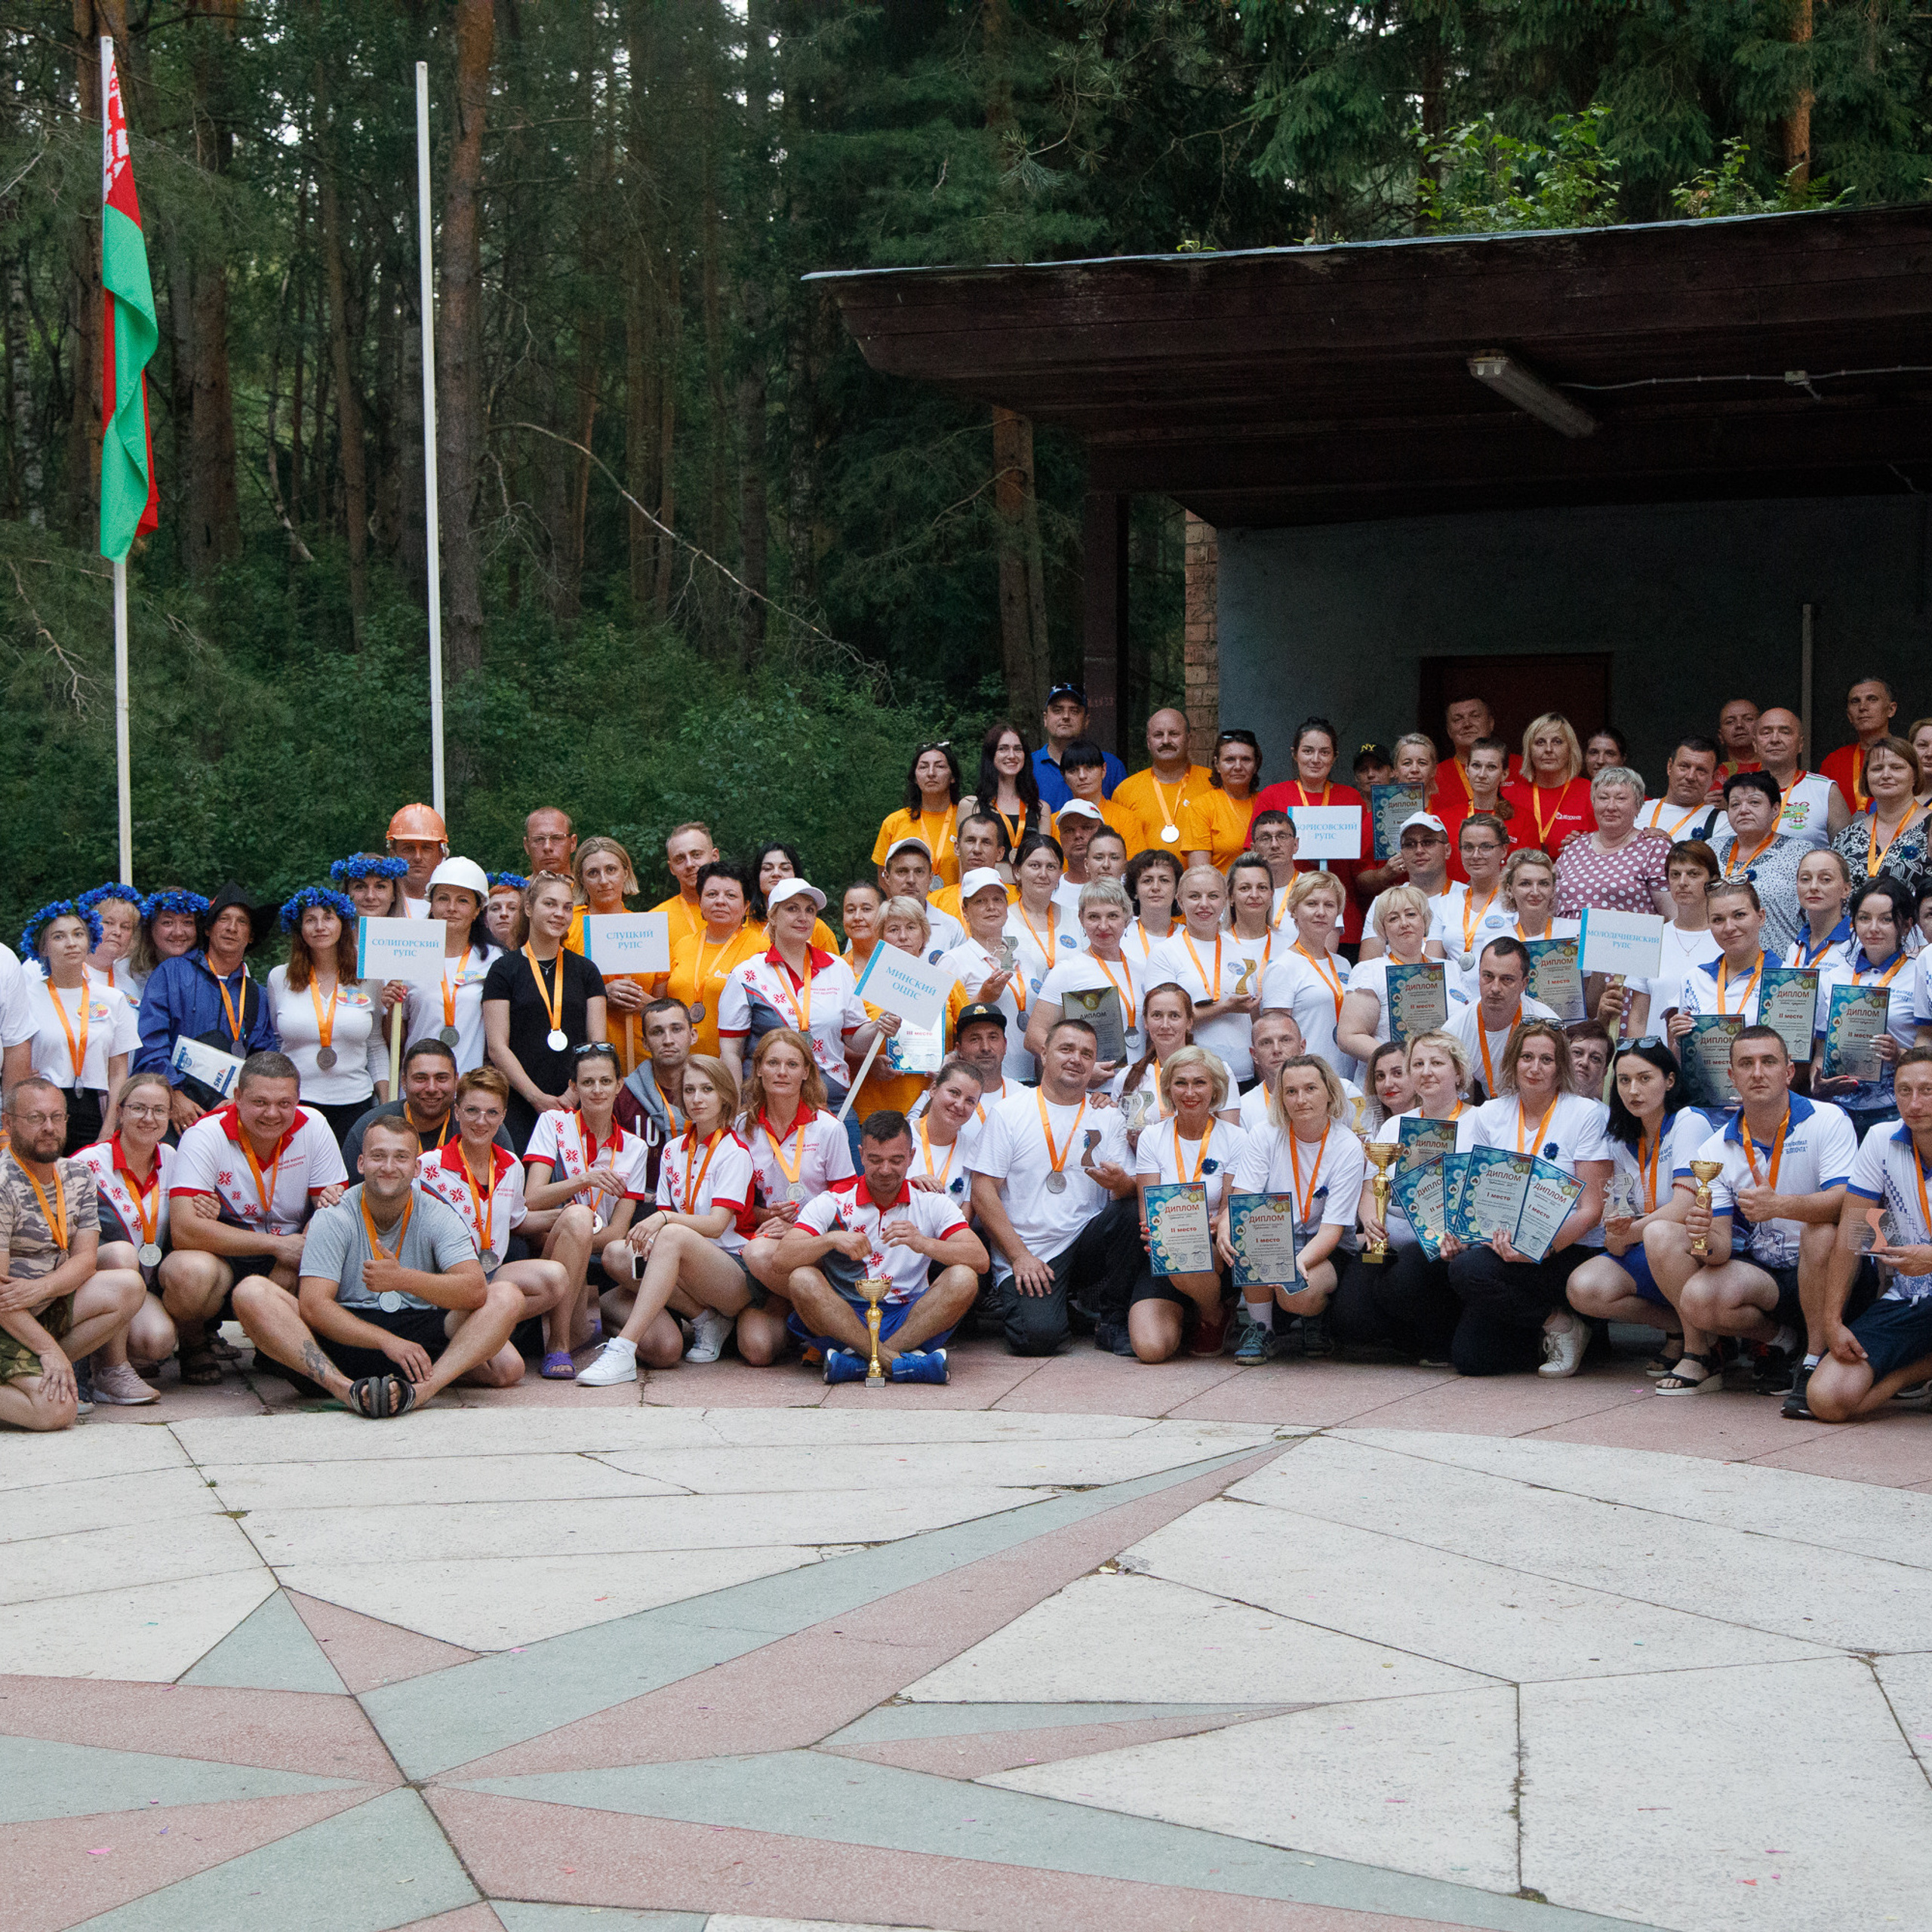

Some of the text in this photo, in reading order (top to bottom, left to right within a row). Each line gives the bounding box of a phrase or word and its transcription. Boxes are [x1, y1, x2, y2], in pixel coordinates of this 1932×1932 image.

[1360, 743, 1376, 752] NY
[1315, 832, 1337, 841] РУПС
[606, 929, 654, 940] СЛУЦКИЙ
[1587, 930, 1660, 943] МОЛОДЕЧНЕНСКИЙ
[371, 938, 439, 948] СОЛИГОРСКИЙ
[618, 941, 643, 950] РУПС
[1613, 941, 1631, 949] РУПС
[393, 949, 417, 957] РУПС
[1541, 958, 1574, 967] ДИПЛОМ
[886, 966, 937, 996] МИНСКИЙ
[892, 982, 921, 1001] ОЦПС
[1405, 983, 1438, 992] ДИПЛОМ
[1081, 1011, 1107, 1020] ДИПЛОМ
[1846, 1008, 1880, 1017] ДИПЛОМ
[213, 1072, 223, 1088] EMS
[1416, 1140, 1448, 1149] ДИПЛОМ
[1486, 1170, 1521, 1182] ДИПЛОМ
[1417, 1178, 1443, 1198] ДИПЛО
[1491, 1193, 1511, 1201] место
[1533, 1183, 1567, 1204] ДИПЛОМ
[1164, 1204, 1199, 1214] ДИПЛОМ
[1532, 1208, 1550, 1219] место
[1249, 1214, 1284, 1223] ДИПЛОМ
